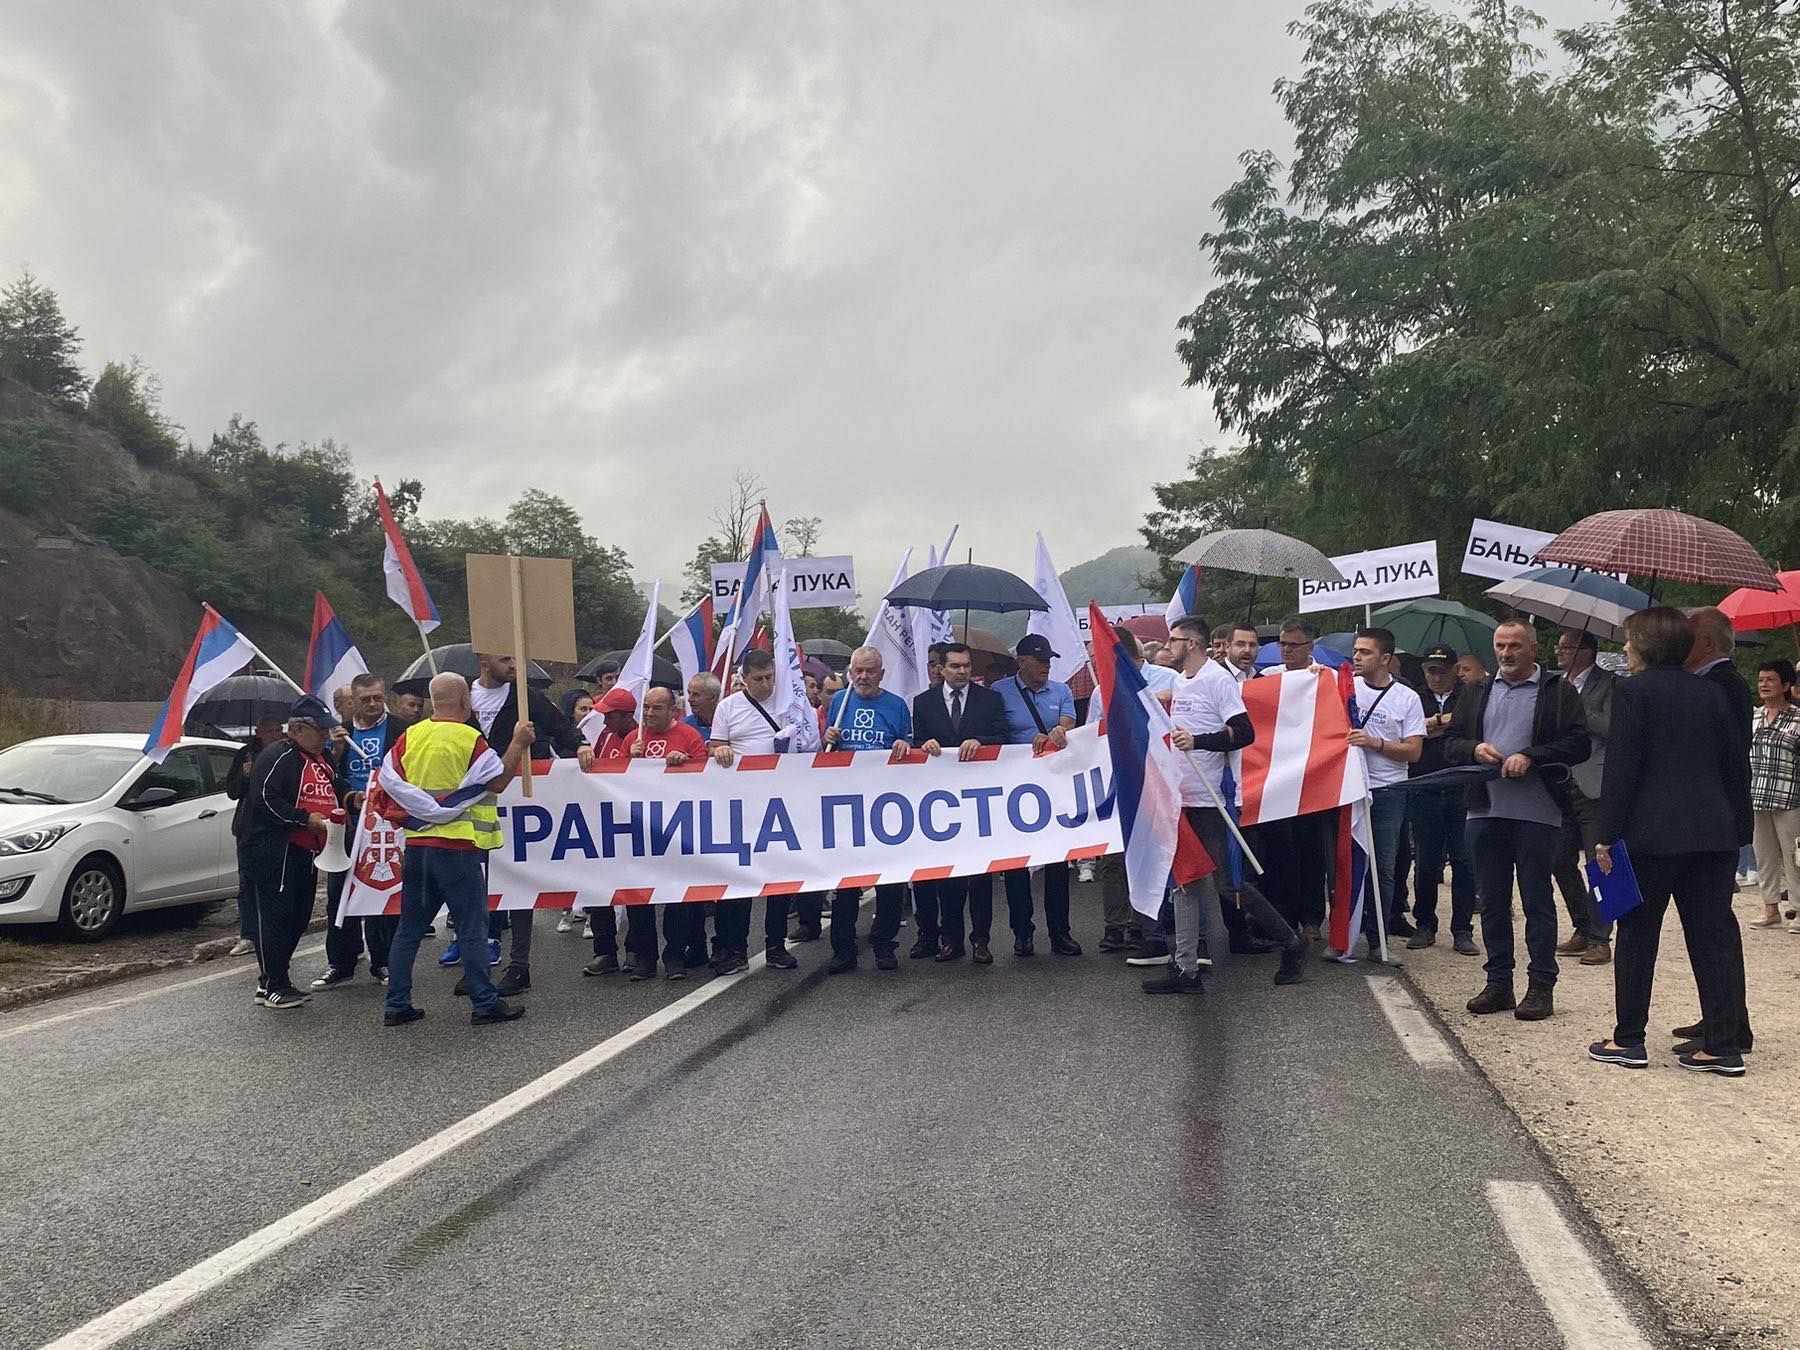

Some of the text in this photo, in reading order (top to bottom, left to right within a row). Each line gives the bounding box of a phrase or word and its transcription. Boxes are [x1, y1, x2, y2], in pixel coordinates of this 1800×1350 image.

[792, 572, 852, 593] ЛУКА
[1302, 559, 1434, 596] БАЊА ЛУКА
[841, 728, 885, 744] СНСД
[497, 766, 1117, 867] РАНИЦА ПОСТОЈИ
